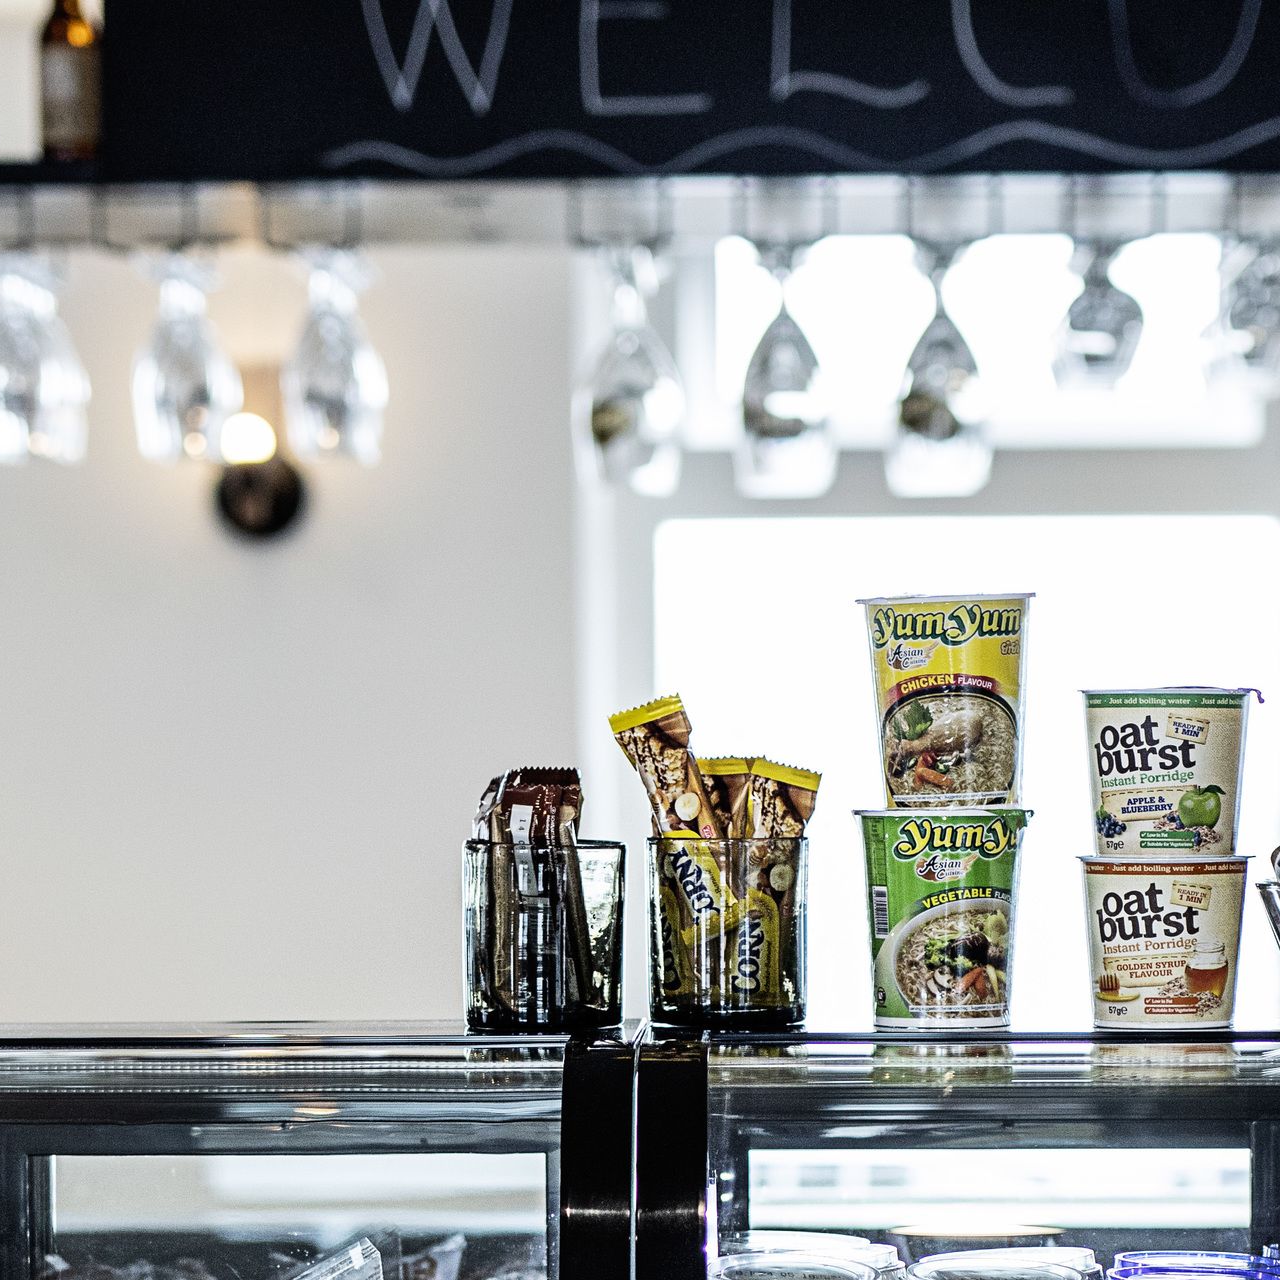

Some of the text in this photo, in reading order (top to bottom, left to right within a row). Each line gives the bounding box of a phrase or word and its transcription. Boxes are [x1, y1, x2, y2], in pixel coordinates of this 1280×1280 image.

[889, 643, 924, 664] Asian
[900, 674, 993, 694] CHICKEN FLAVOUR
[1108, 697, 1123, 705] Just
[1138, 697, 1167, 706] boiling
[1100, 715, 1160, 751] oat
[1173, 721, 1196, 731] READY
[1181, 729, 1201, 738] MIN
[1094, 741, 1196, 778] burst
[1100, 770, 1195, 789] Instant Porridge
[1121, 803, 1174, 815] BLUEBERRY
[1127, 796, 1166, 806] APPLE &
[894, 817, 983, 860] Yum
[919, 856, 962, 875] Asian
[1112, 864, 1127, 872] Just
[1127, 864, 1142, 872] add
[1143, 864, 1171, 873] boiling
[922, 888, 992, 909] VEGETABLE
[1102, 882, 1165, 918] oat
[1177, 888, 1200, 898] READY
[1185, 896, 1203, 905] MIN
[1096, 907, 1200, 944] burst
[1103, 937, 1198, 955] Instant Porridge
[1116, 960, 1187, 972] GOLDEN SYRUP
[1129, 969, 1173, 979] FLAVOUR
